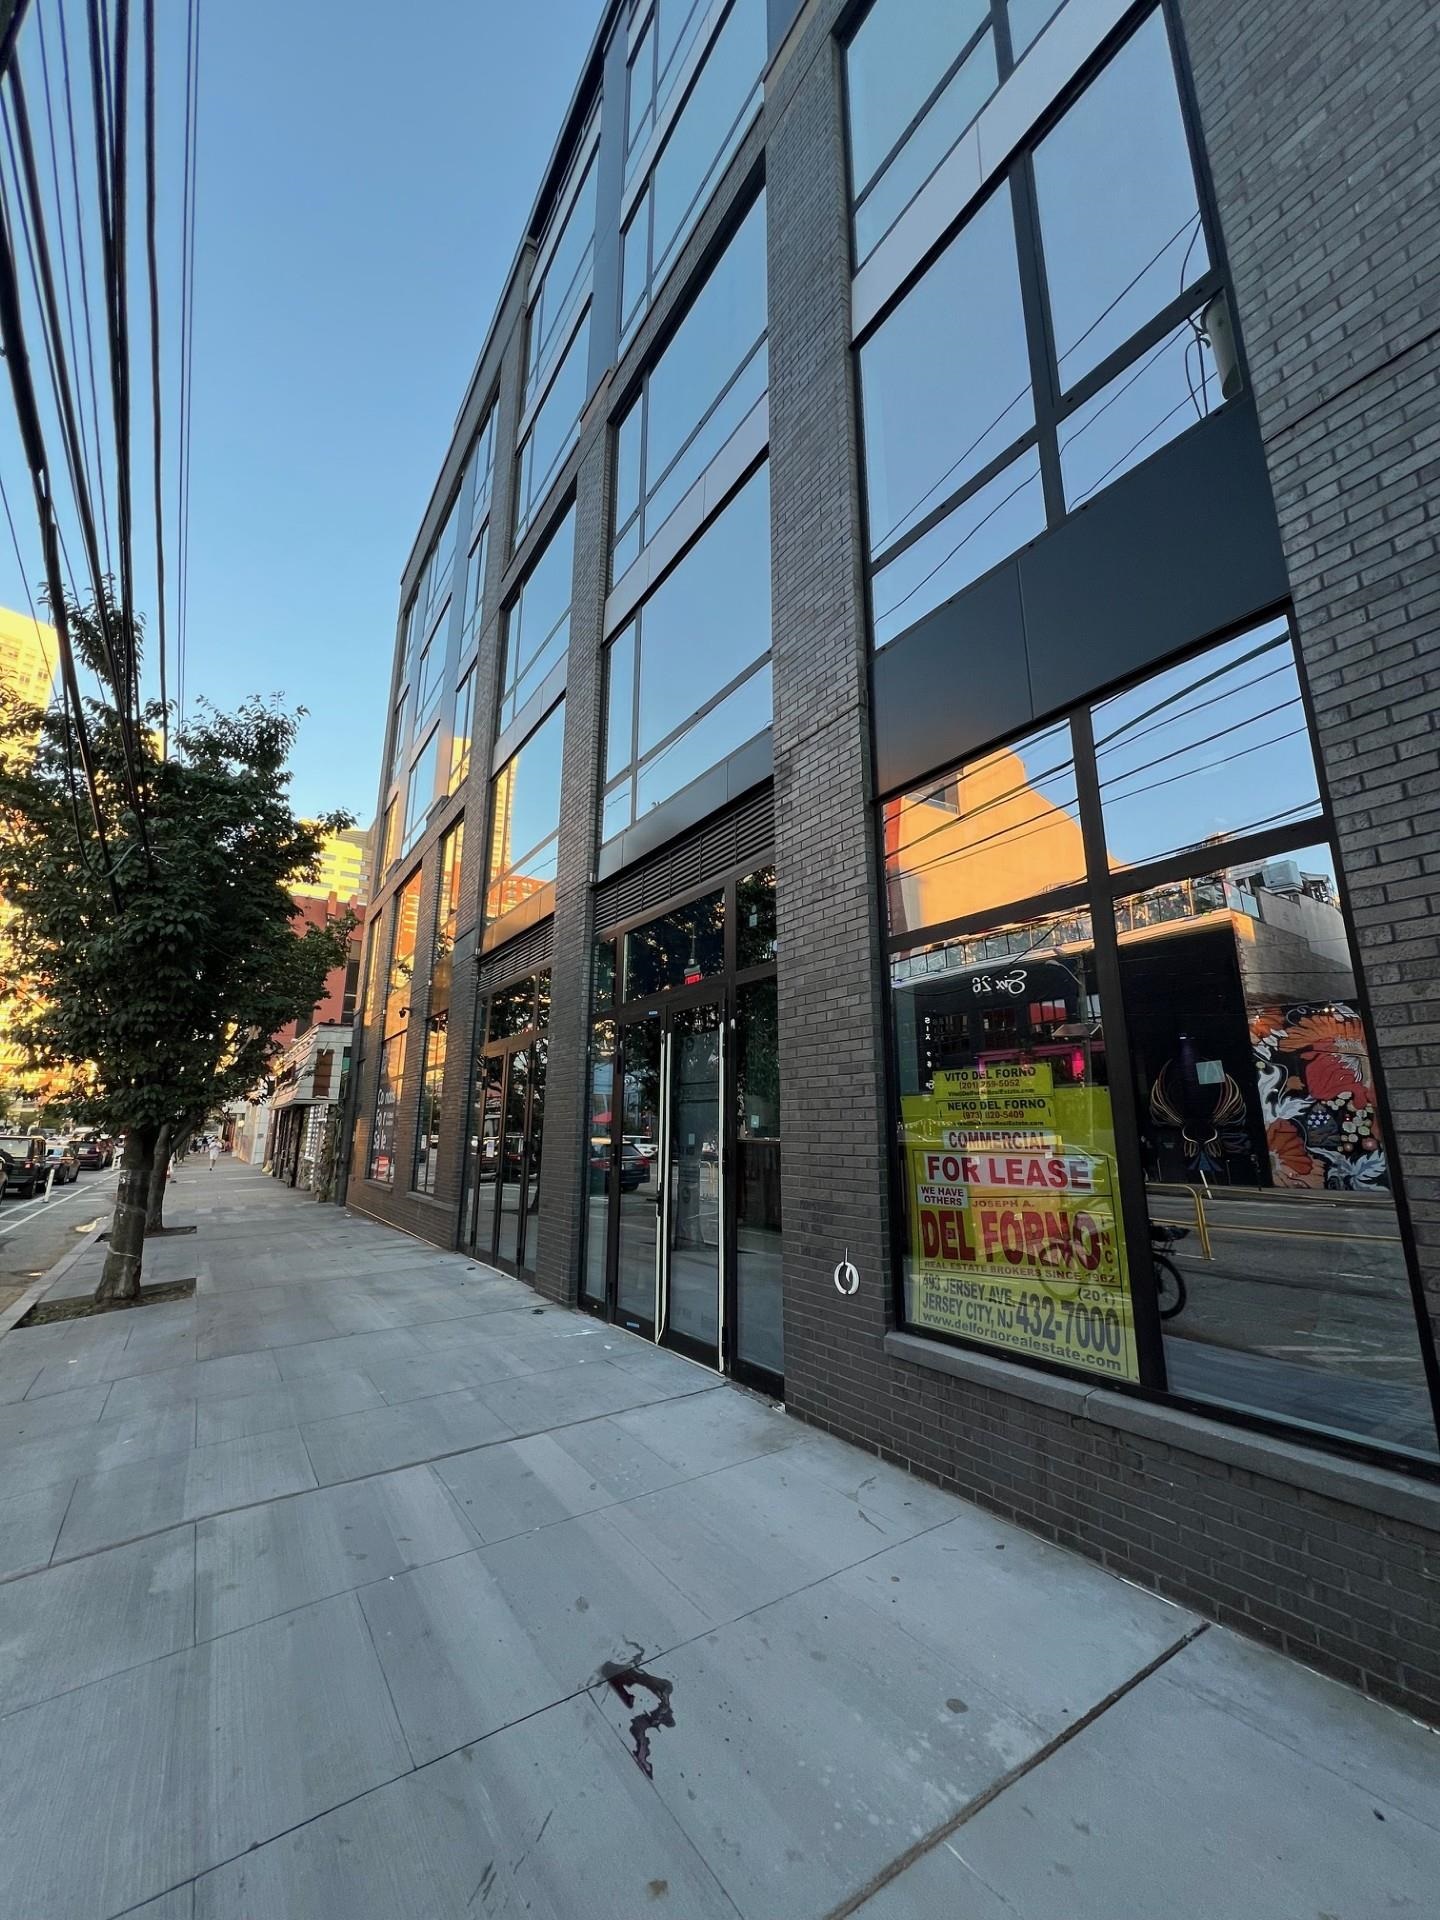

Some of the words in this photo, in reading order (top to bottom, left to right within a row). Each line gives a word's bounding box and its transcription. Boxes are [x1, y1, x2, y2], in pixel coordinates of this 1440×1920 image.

[944, 1071, 969, 1081] VITO
[972, 1069, 993, 1080] DEL
[995, 1066, 1037, 1079] FORNO
[959, 1081, 979, 1089] (201)
[947, 1102, 977, 1111] NEKO
[980, 1100, 1002, 1110] DEL
[1004, 1098, 1046, 1110] FORNO
[963, 1110, 982, 1120] (973)
[948, 1130, 1051, 1150] COMMERCIAL
[926, 1156, 980, 1184] FOR
[988, 1157, 1092, 1190] LEASE
[920, 1186, 936, 1195] WE
[937, 1186, 965, 1198] HAVE
[923, 1195, 963, 1206] OTHERS
[972, 1199, 1019, 1208] JOSEPH
[920, 1209, 977, 1261] DEL
[980, 1209, 1102, 1271] FORNO
[924, 1260, 948, 1269] REAL
[950, 1262, 987, 1273] ESTATE
[990, 1265, 1042, 1277] BROKERS
[1045, 1271, 1084, 1281] SINCE
[943, 1277, 985, 1302] JERSEY
[1077, 1286, 1116, 1305] (201)
[922, 1292, 963, 1317] JERSEY
[965, 1302, 995, 1327] CITY,
[996, 1307, 1014, 1330] NJ
[1015, 1290, 1121, 1357] 432-7000
[922, 1312, 1122, 1371] www.delfornorealestate.com
